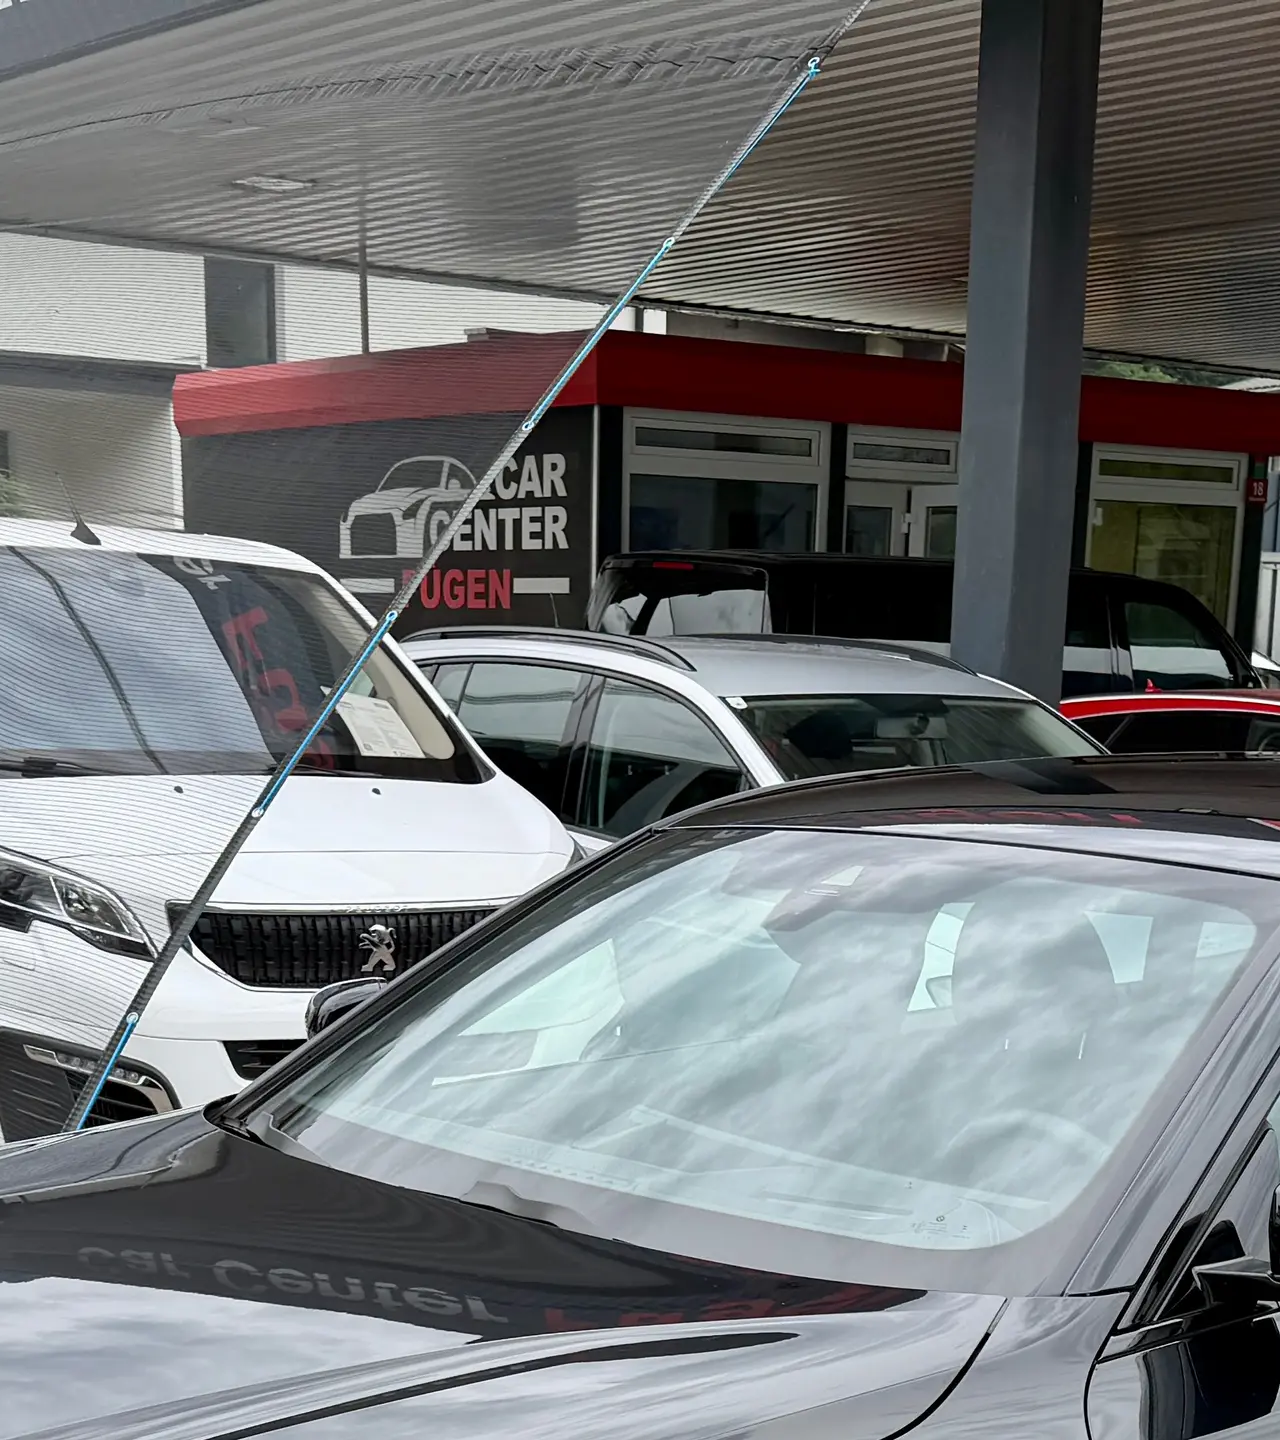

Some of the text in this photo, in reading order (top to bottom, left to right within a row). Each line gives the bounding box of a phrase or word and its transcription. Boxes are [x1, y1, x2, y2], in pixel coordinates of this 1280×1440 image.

[494, 453, 568, 501] CAR
[1252, 481, 1264, 496] 18
[428, 506, 570, 552] CENTER
